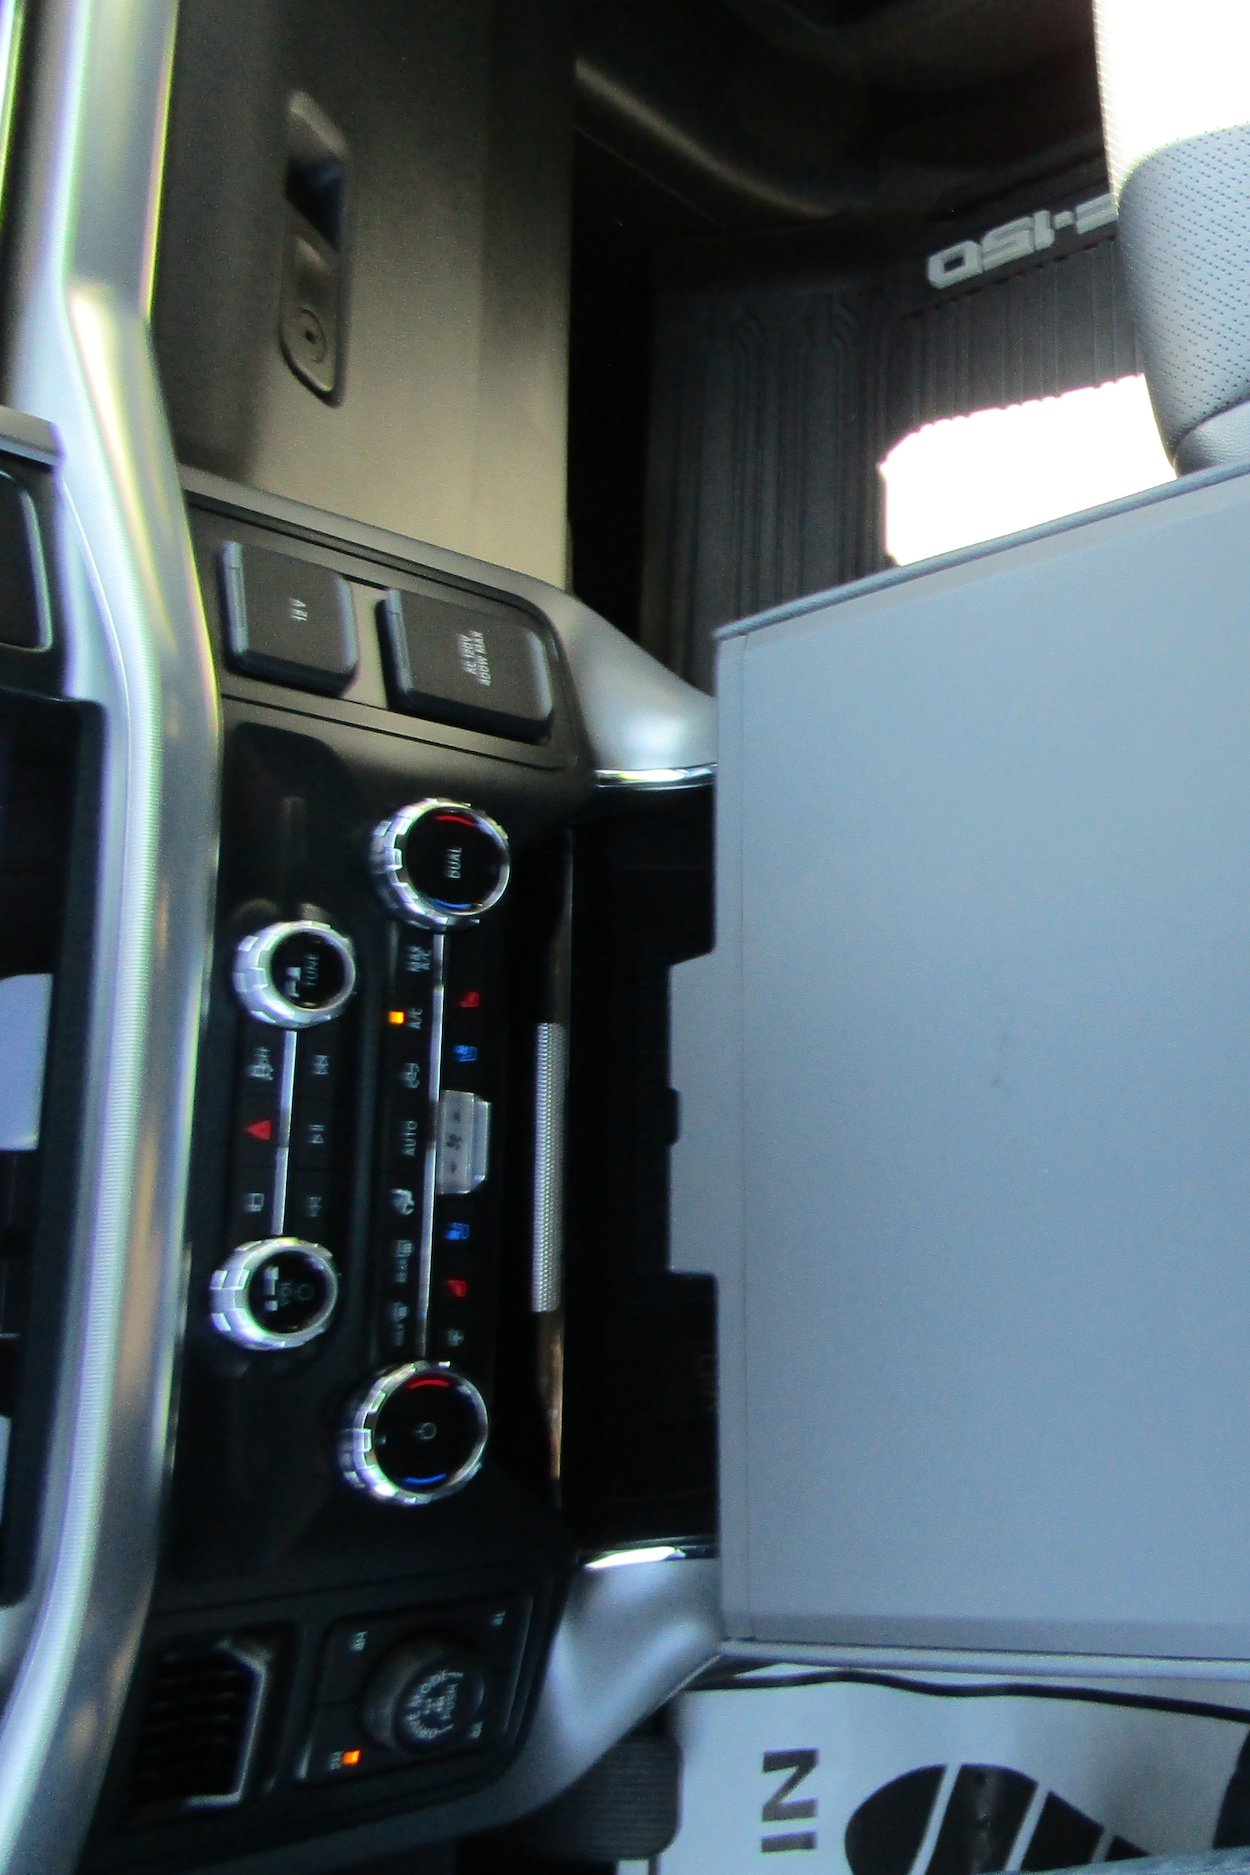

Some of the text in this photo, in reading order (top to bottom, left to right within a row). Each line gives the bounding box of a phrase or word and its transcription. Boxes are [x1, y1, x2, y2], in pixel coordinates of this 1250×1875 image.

[469, 630, 487, 655] MAX
[463, 661, 478, 676] AC
[445, 846, 463, 879] DUAL
[302, 952, 320, 987] TUNE
[409, 1007, 424, 1030] A/C
[401, 1119, 418, 1156] AUTO
